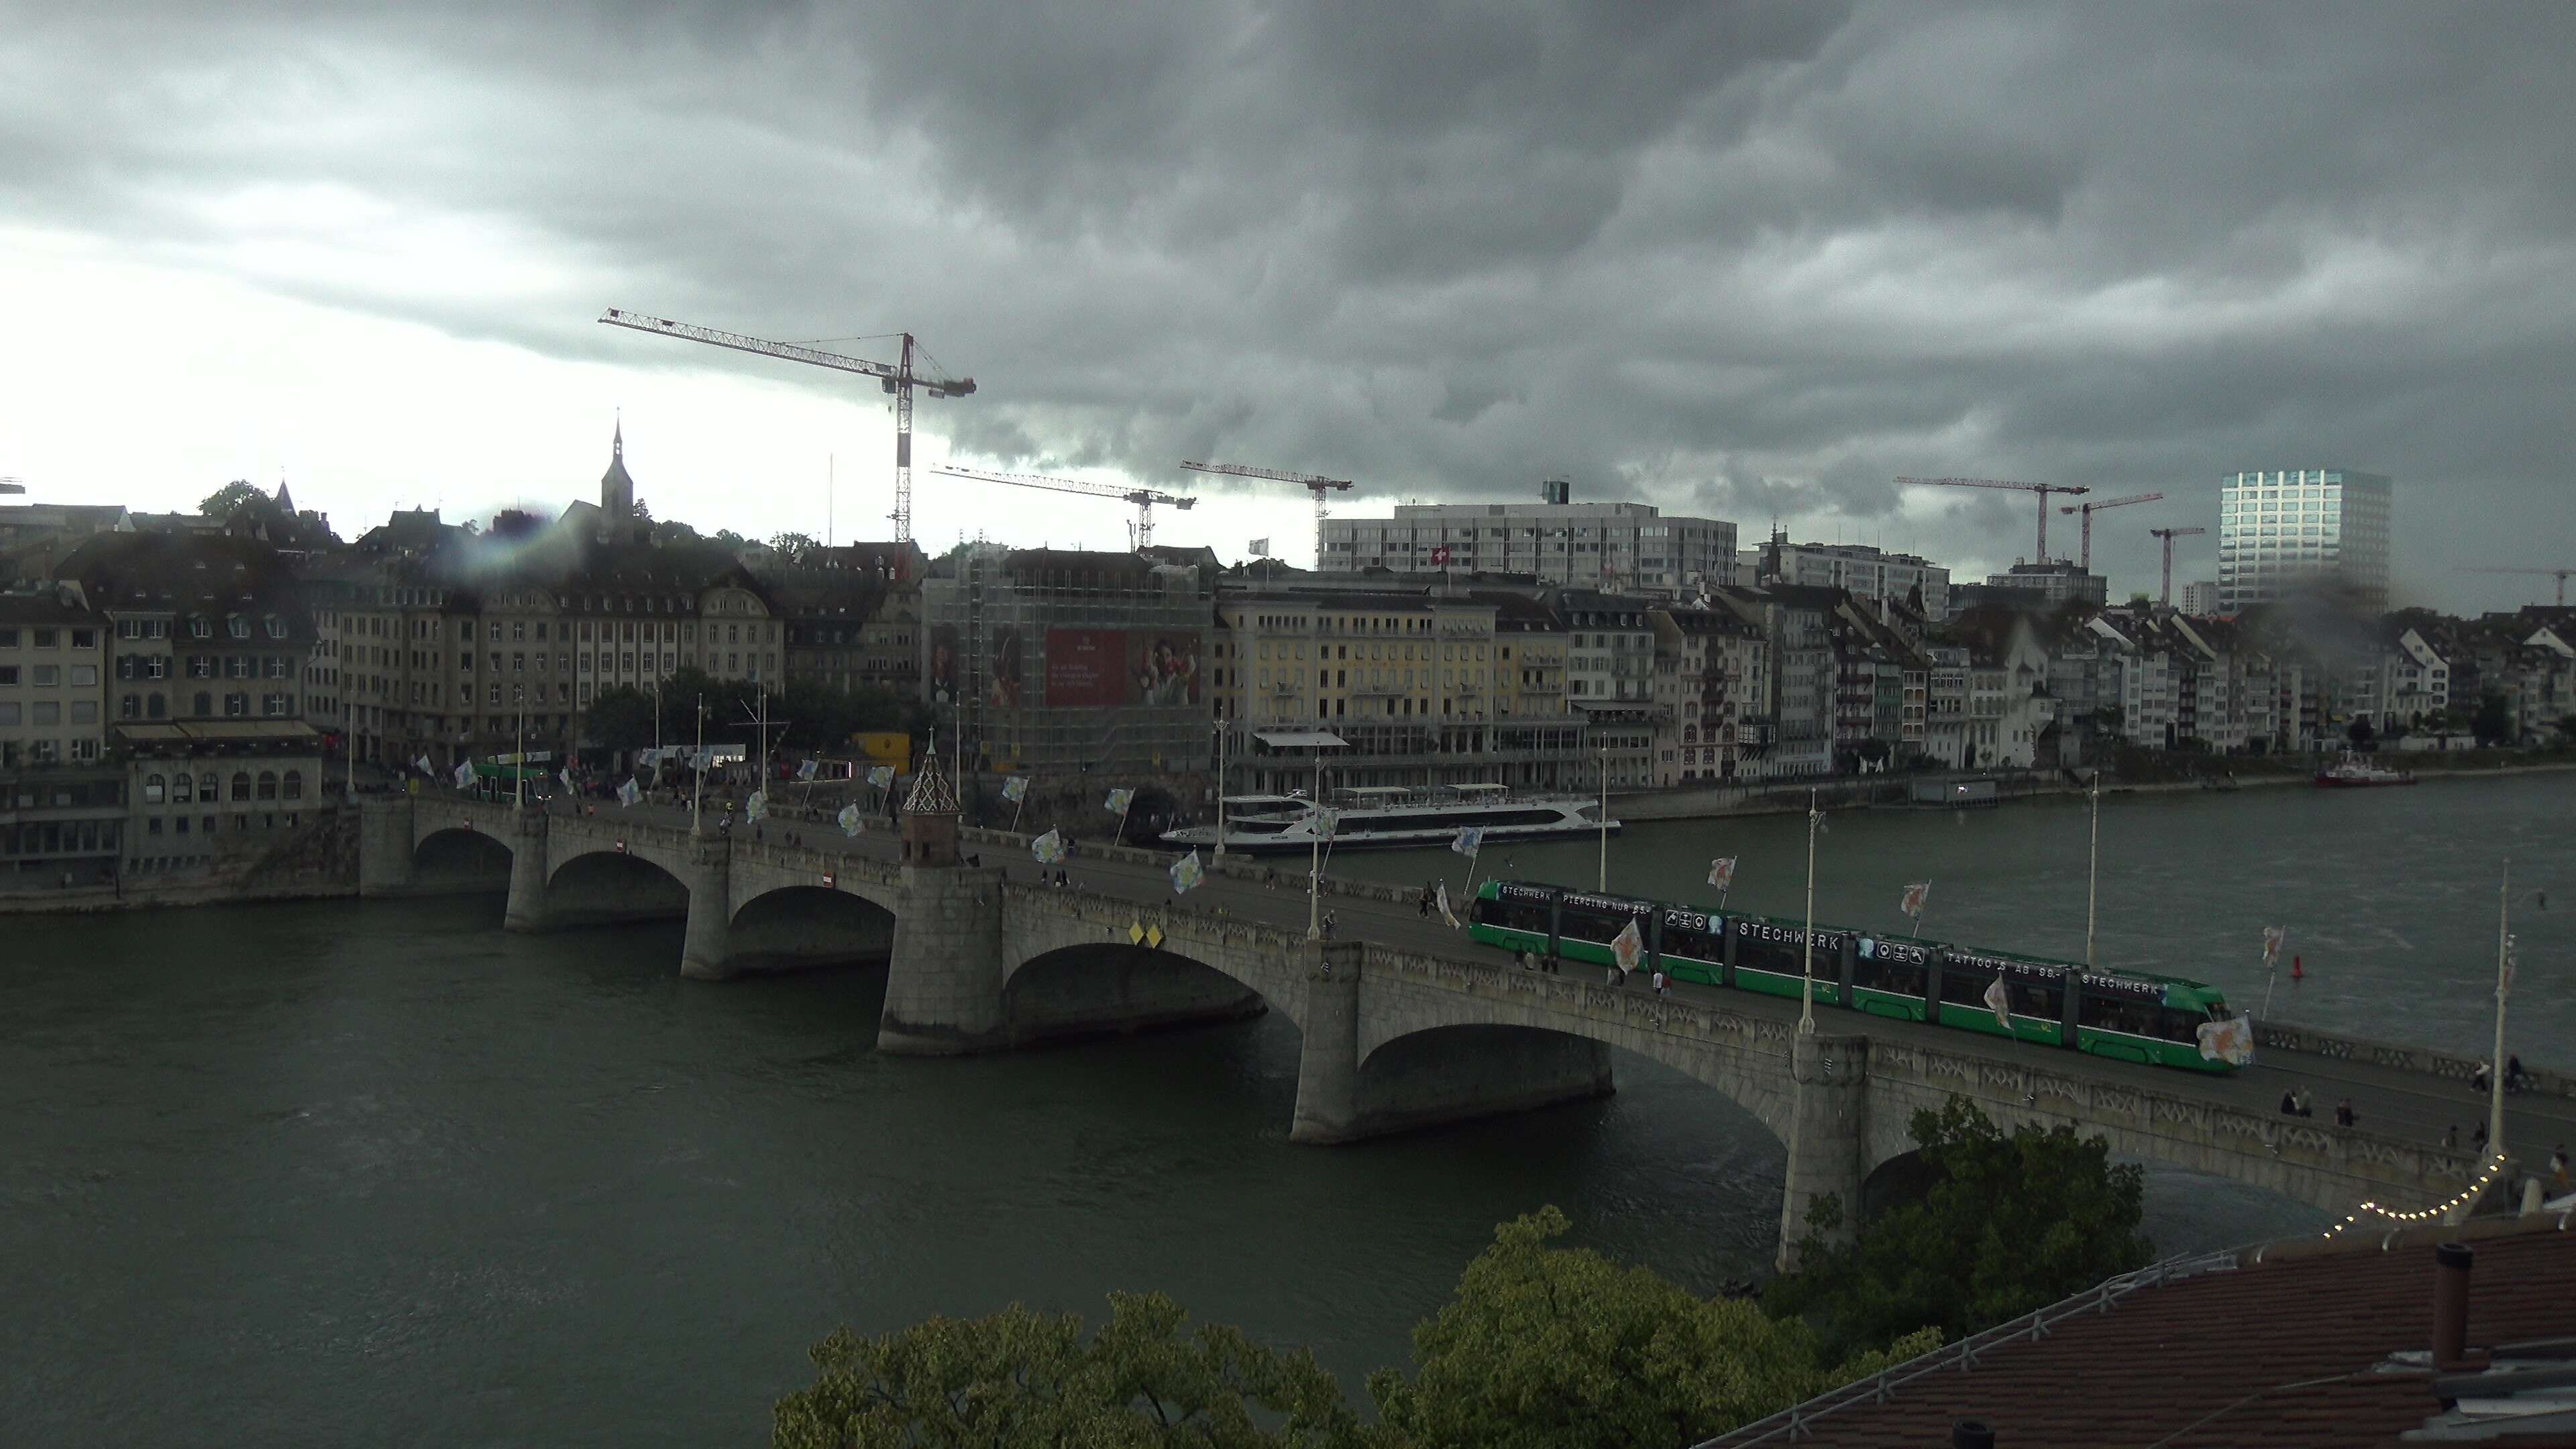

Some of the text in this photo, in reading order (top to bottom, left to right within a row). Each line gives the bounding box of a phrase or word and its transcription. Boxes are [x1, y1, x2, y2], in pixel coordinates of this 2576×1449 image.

[1502, 885, 1550, 900] STECHWERK
[1562, 895, 1607, 909] PIERCING
[1611, 902, 1629, 912] NUR
[1739, 922, 1839, 950] STECHWERK
[1947, 953, 2006, 971] TATTOO'S
[2015, 965, 2029, 975] AB
[2082, 974, 2158, 994] STECHWERK
